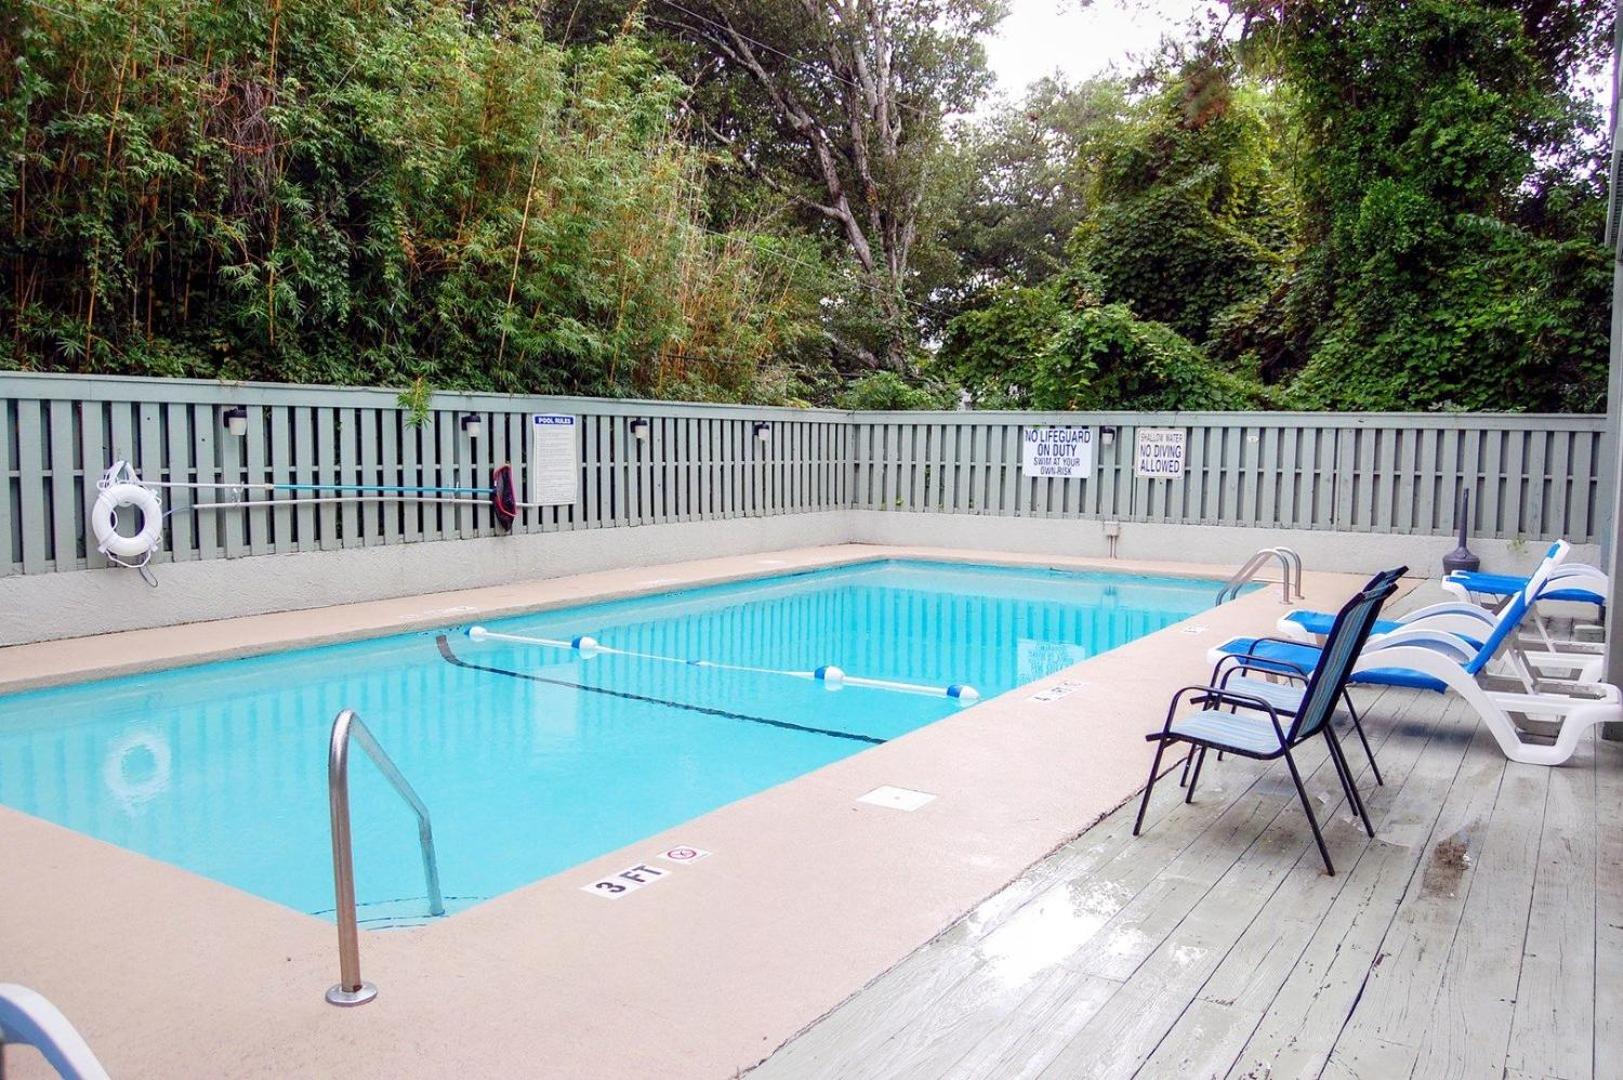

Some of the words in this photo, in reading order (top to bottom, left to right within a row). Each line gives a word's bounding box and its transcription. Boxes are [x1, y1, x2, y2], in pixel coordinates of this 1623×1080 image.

[1025, 429, 1039, 443] NO
[1040, 430, 1091, 444] LIFEGUARD
[1140, 433, 1164, 442] SHALLOW
[1165, 433, 1183, 443] WATER
[1037, 443, 1051, 456] ON
[1052, 443, 1077, 457] DUTY
[1140, 444, 1151, 458] NO
[1153, 444, 1182, 459] DIVING
[1033, 457, 1052, 466] SWIM
[1053, 457, 1061, 466] AT
[1062, 457, 1081, 467] YOUR
[1140, 459, 1180, 473] ALLOWED
[1057, 466, 1072, 476] RISK
[595, 882, 626, 893] 3
[619, 865, 662, 883] FT
